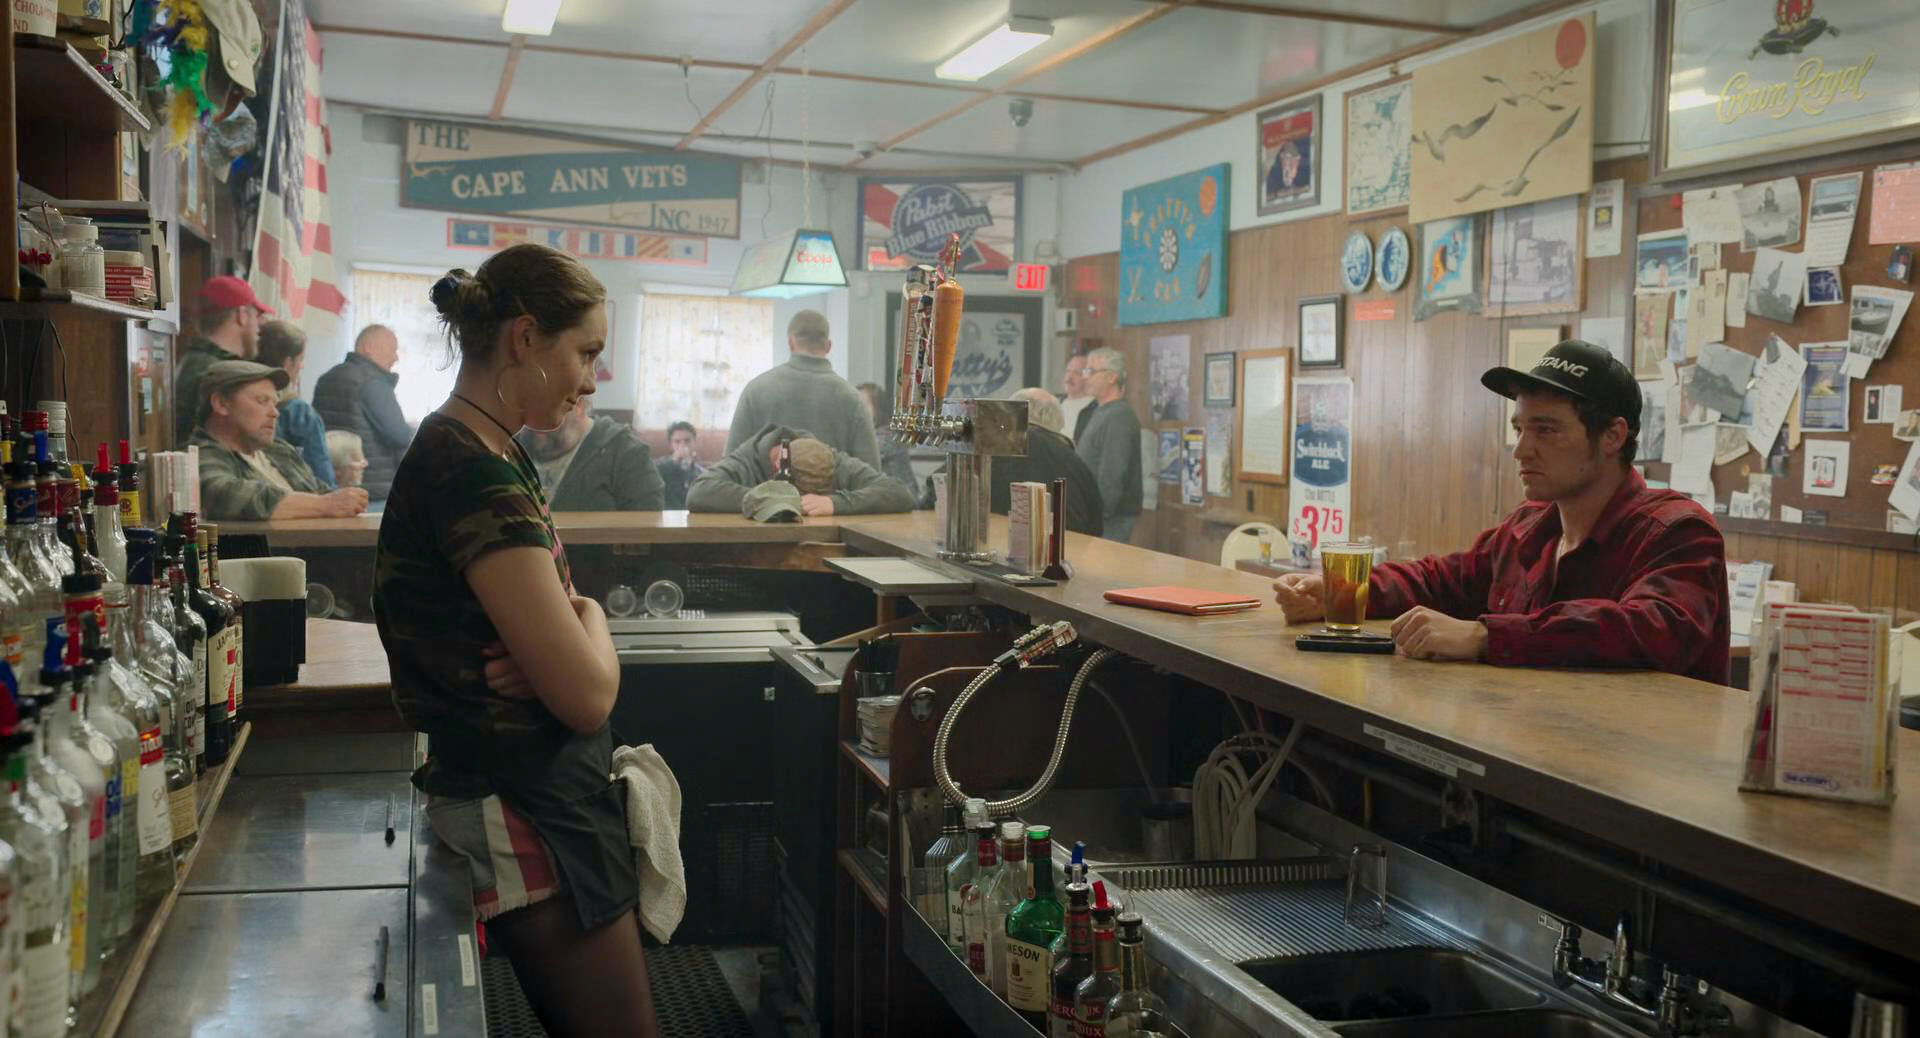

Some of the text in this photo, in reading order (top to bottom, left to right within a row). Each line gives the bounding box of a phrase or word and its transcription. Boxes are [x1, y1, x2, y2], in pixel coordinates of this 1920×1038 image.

[1716, 52, 1878, 124] Crown Royal
[414, 122, 470, 150] THE
[452, 165, 689, 199] CAPE ANN VETS
[649, 204, 729, 232] INC 1947
[905, 192, 954, 227] Pabst
[886, 211, 989, 258] Blue Ribbon
[1016, 264, 1048, 289] EXIT
[1536, 357, 1588, 377] STANG
[1311, 459, 1331, 470] ALE
